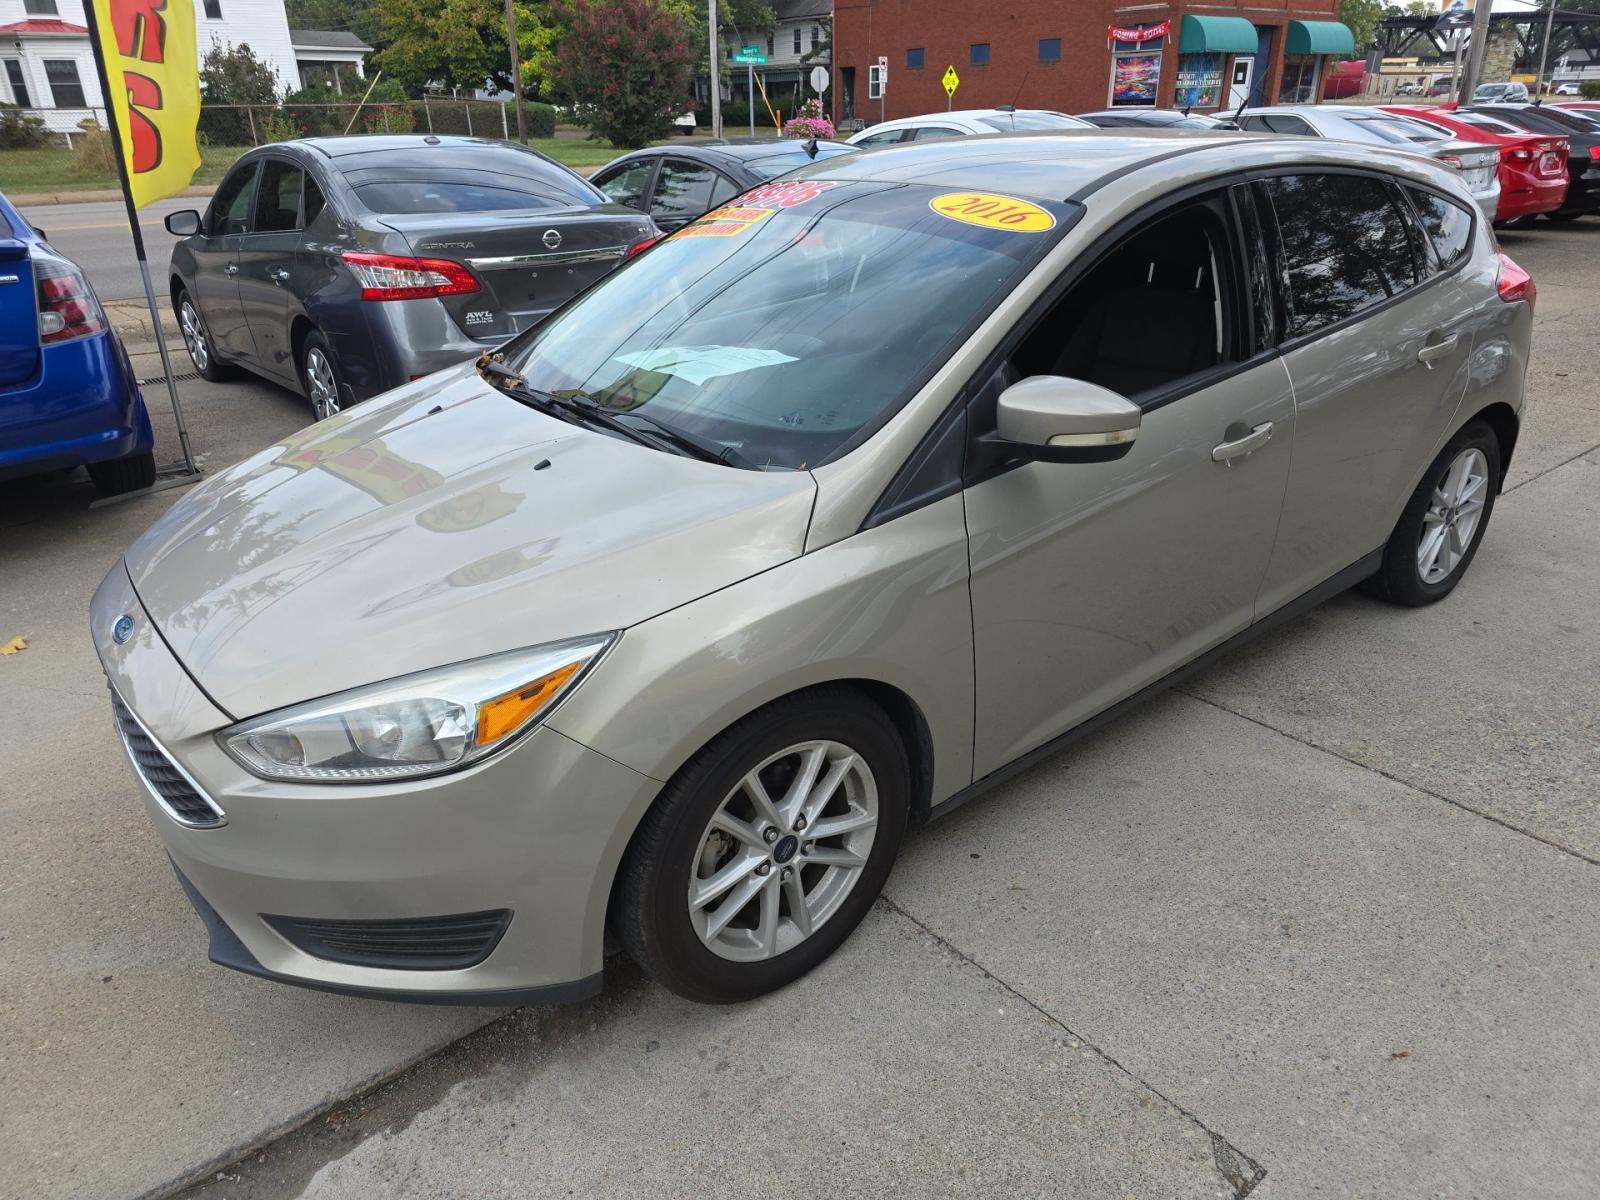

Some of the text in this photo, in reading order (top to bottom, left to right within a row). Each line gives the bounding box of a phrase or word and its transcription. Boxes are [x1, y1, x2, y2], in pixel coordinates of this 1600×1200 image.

[941, 197, 1044, 225] 2016
[421, 241, 476, 249] SENTRA
[465, 311, 493, 319] AWL
